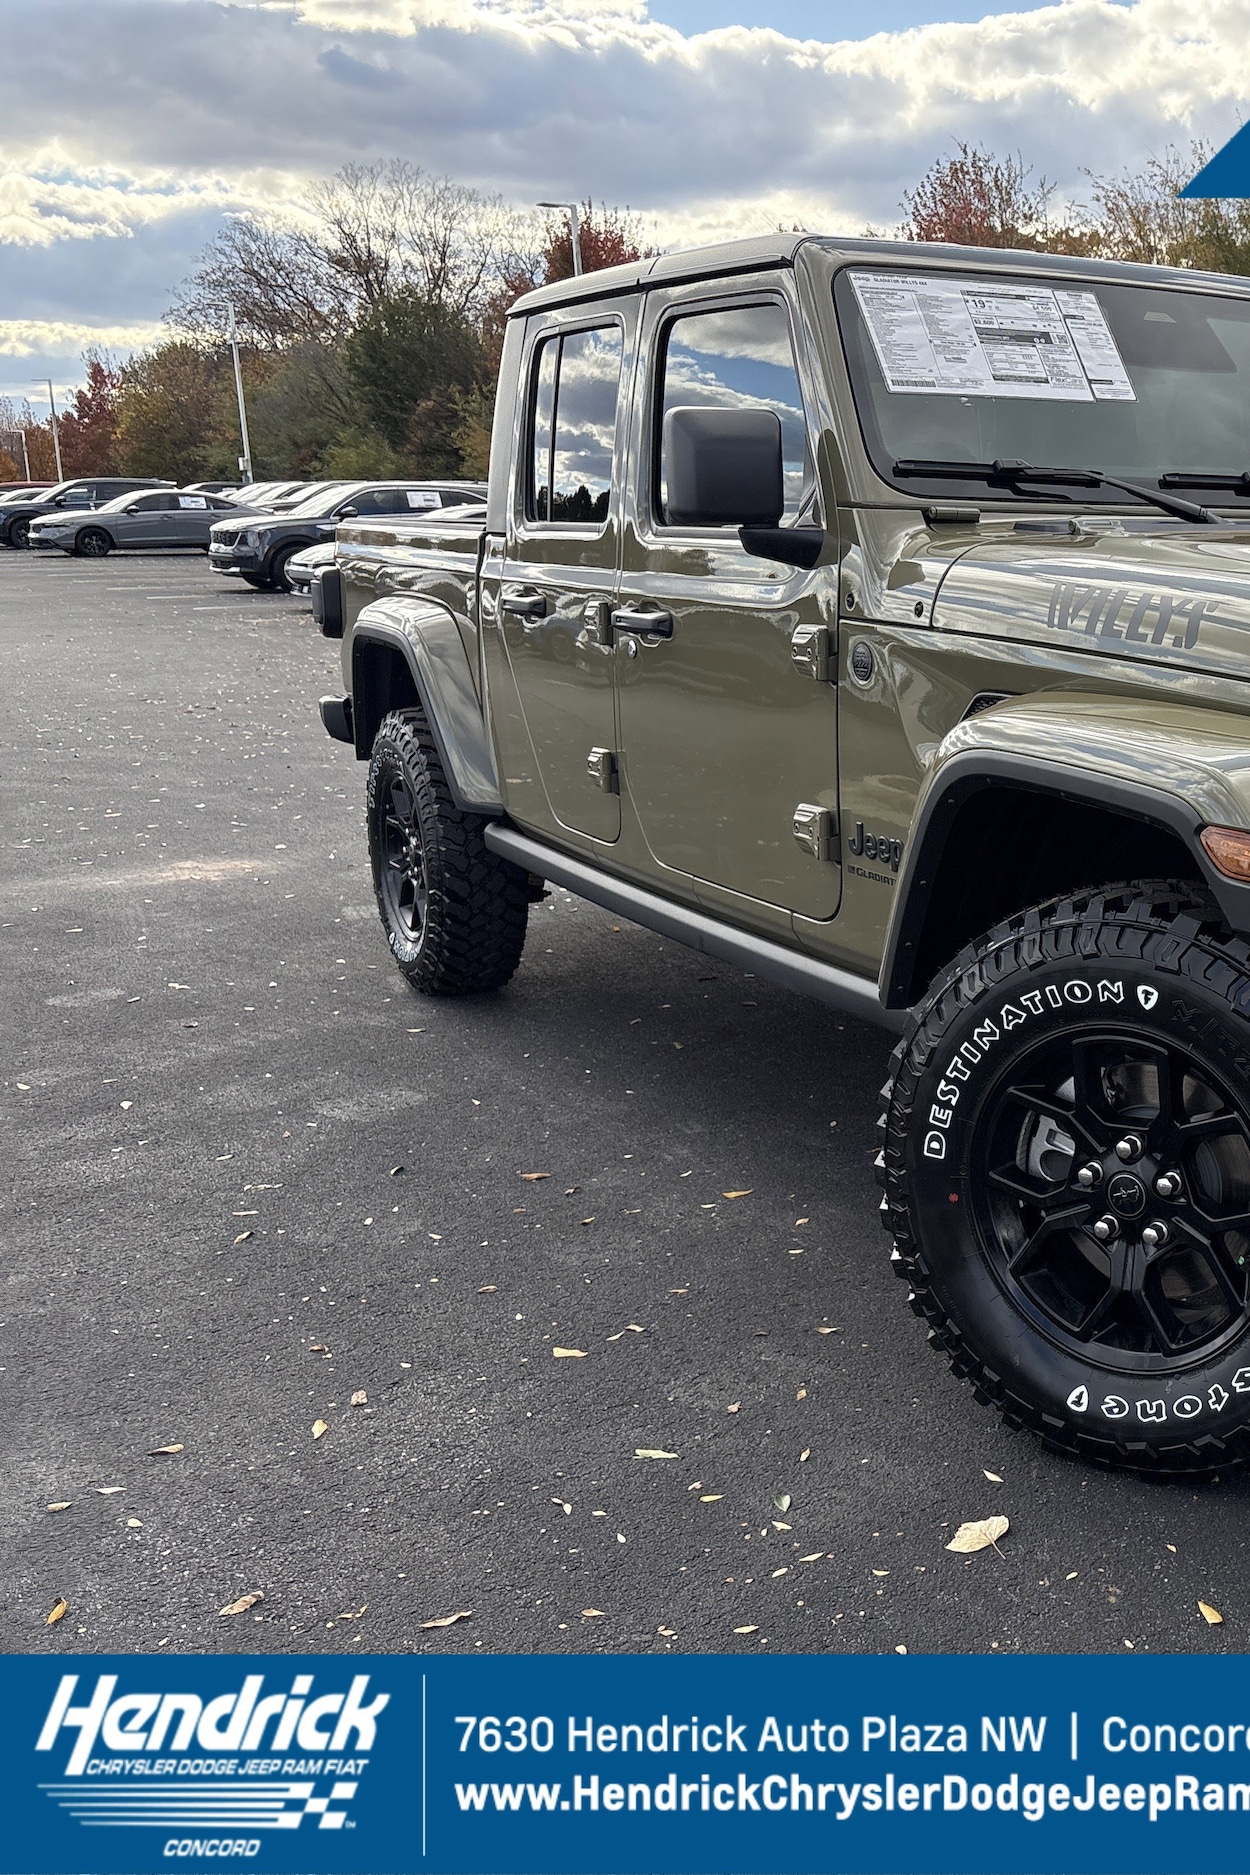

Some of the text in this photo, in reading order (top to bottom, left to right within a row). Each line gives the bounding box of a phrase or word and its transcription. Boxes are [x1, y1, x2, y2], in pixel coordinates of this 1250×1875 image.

[972, 299, 986, 309] 19
[1047, 582, 1220, 650] WILLYS
[848, 820, 904, 873] Jeep
[856, 868, 897, 887] GLADIAT
[923, 979, 1125, 1160] DESTINATION
